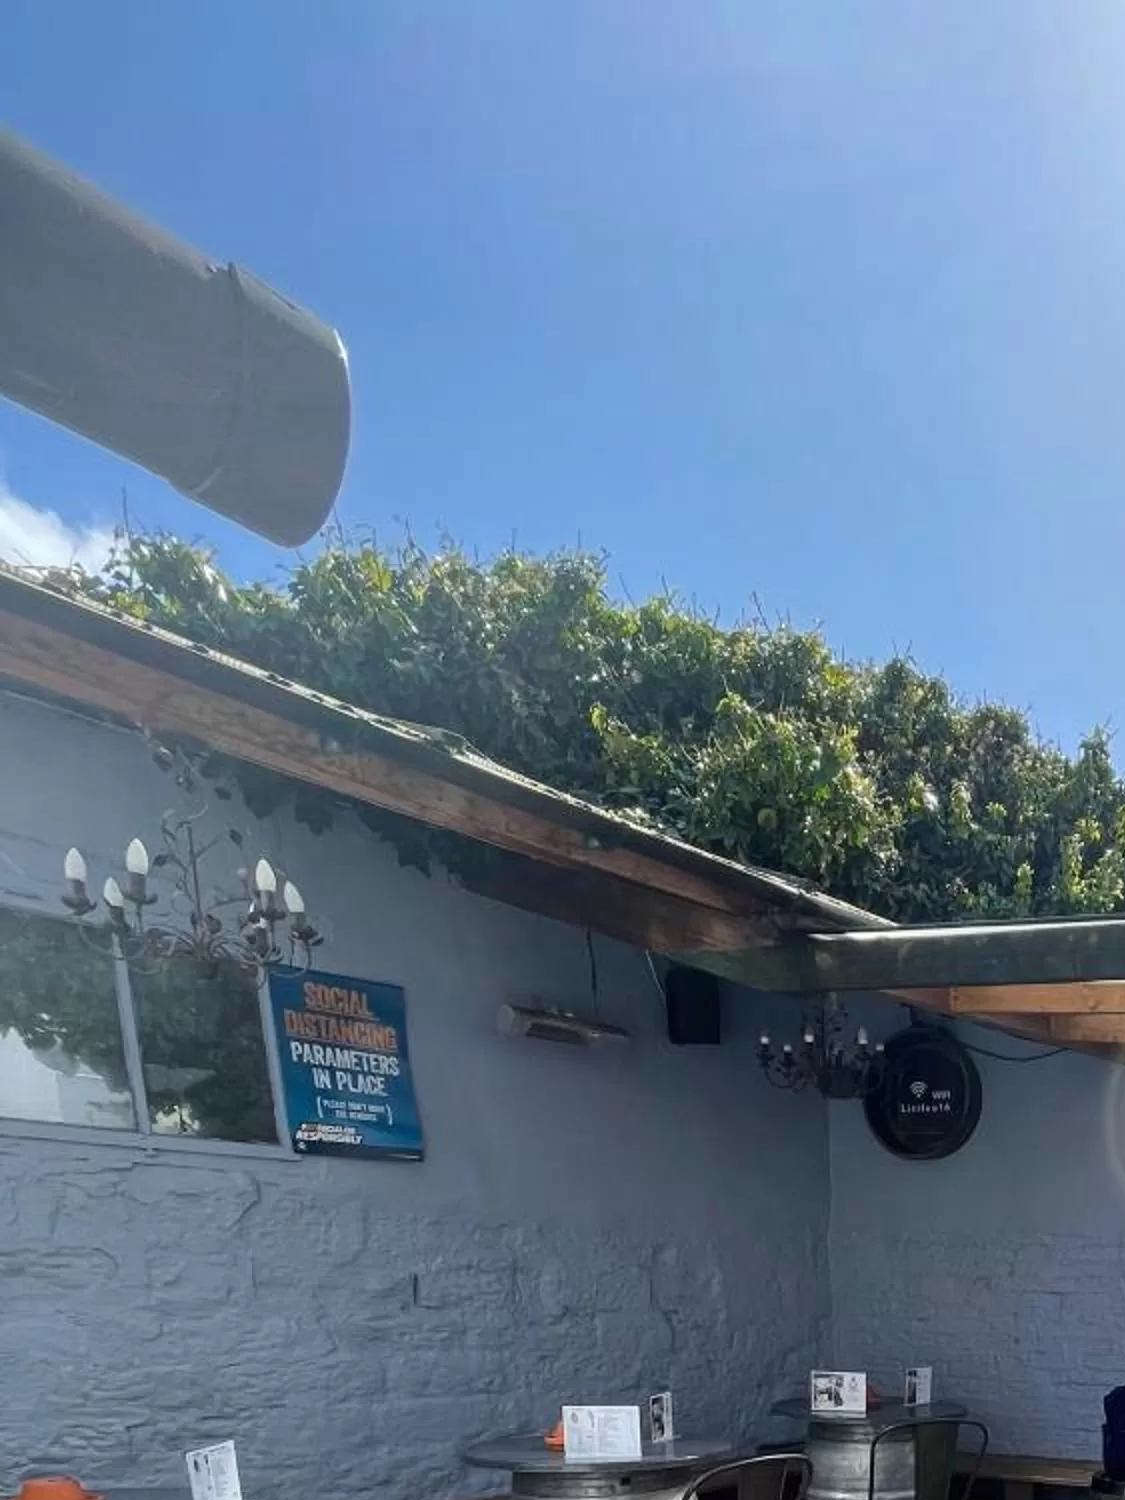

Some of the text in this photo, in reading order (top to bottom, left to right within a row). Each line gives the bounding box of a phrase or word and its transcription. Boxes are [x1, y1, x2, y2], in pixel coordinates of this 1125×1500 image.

[303, 981, 374, 1017] SOCIAL
[284, 1009, 398, 1051] DISTANCING
[290, 1041, 400, 1076] PARAMETERS
[313, 1067, 388, 1096] IN PLACE
